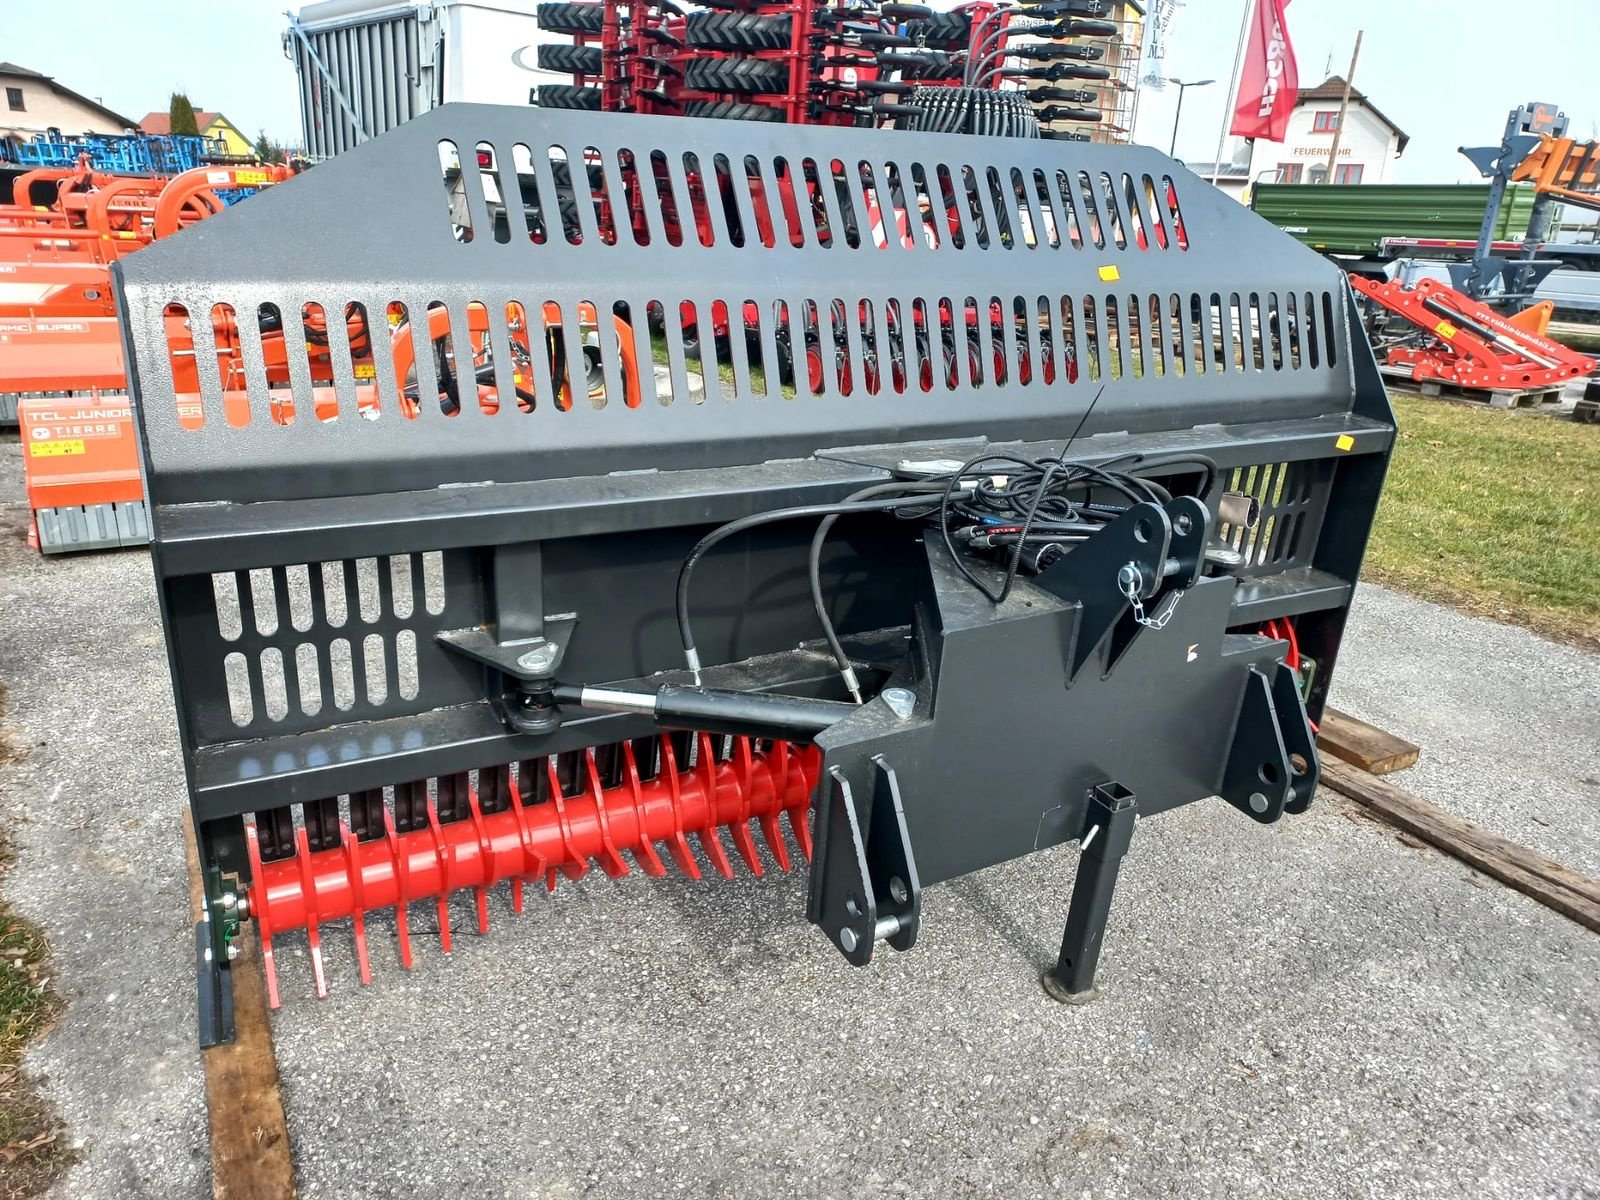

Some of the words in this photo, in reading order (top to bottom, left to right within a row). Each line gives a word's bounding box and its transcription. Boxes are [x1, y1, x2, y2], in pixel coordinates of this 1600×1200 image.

[1293, 147, 1352, 156] FEUERWHR
[30, 411, 66, 421] TCL
[70, 409, 132, 420] JUNIOR
[53, 424, 117, 435] TIERRE
